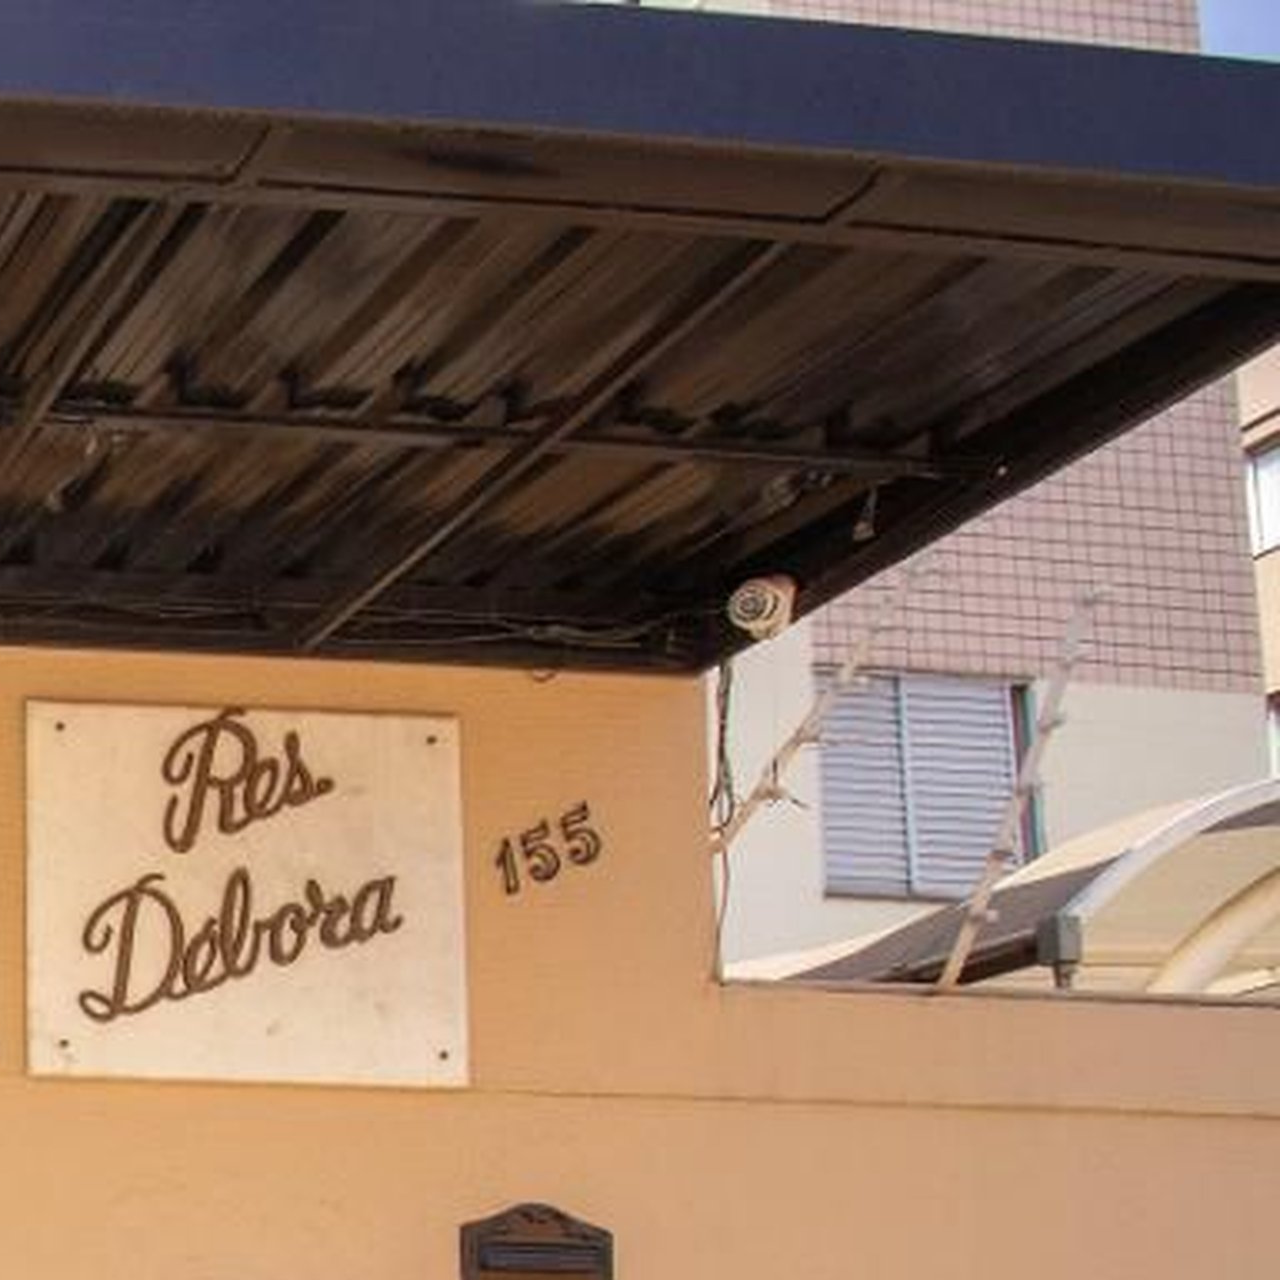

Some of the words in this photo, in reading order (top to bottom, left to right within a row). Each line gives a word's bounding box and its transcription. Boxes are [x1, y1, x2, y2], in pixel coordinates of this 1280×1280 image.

[161, 707, 334, 854] Res.
[494, 800, 604, 896] 155
[78, 866, 402, 1023] Debora
